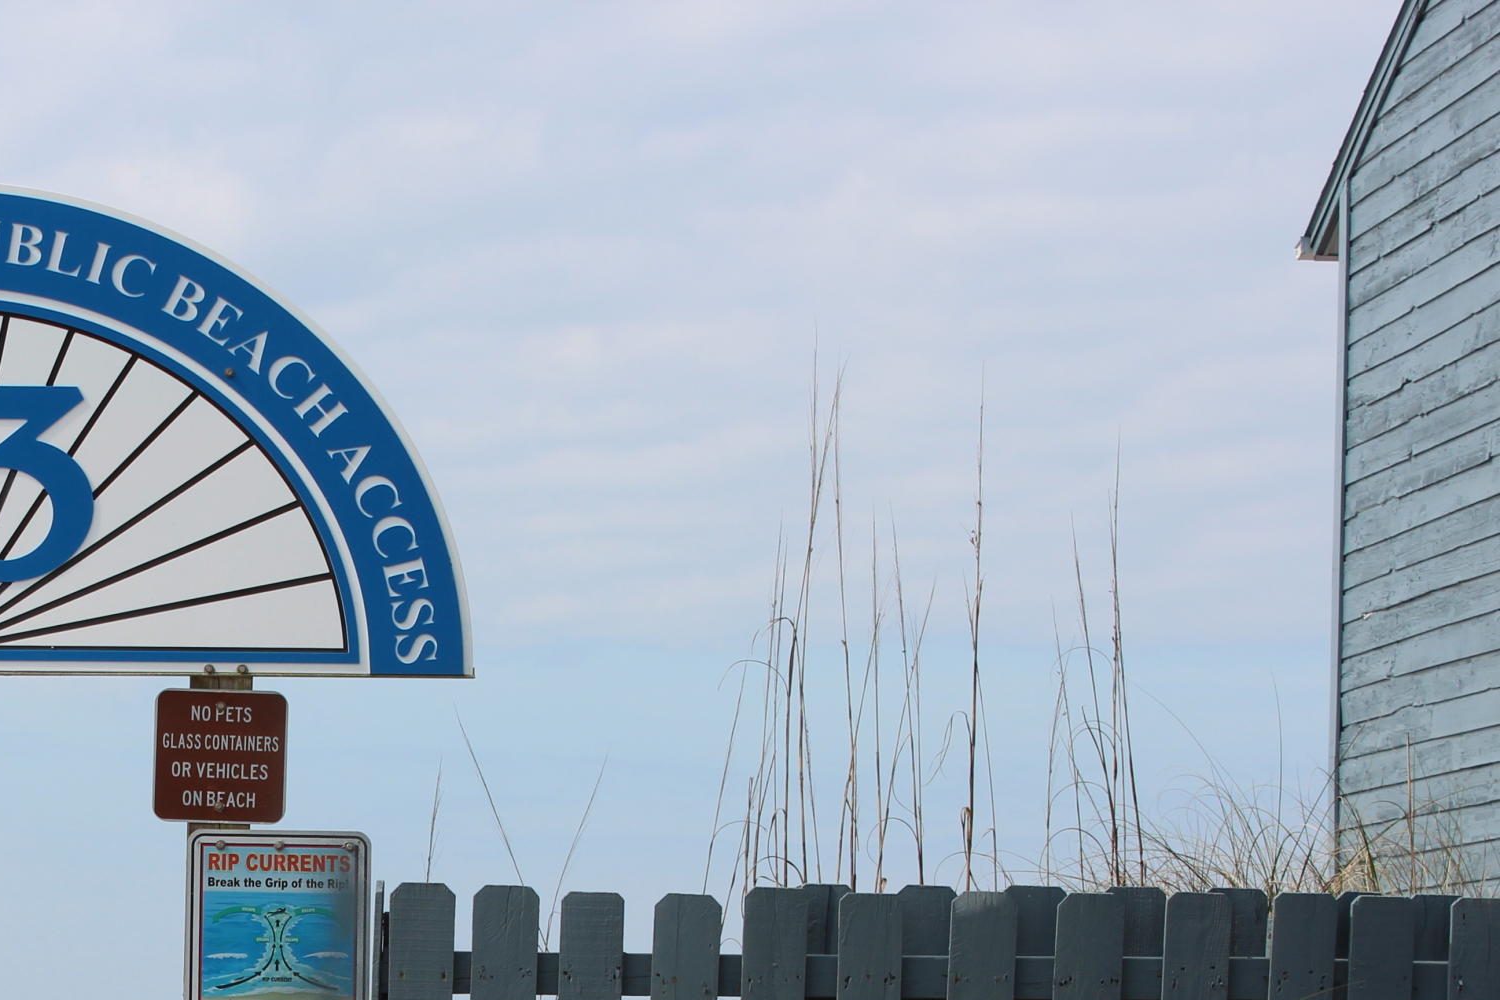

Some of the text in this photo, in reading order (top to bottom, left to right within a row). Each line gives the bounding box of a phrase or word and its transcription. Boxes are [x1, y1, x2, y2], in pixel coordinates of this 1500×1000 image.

[161, 274, 349, 438] BEACH
[327, 443, 438, 665] ACCESS
[191, 705, 252, 723] NO PETS
[162, 733, 279, 752] GLASS CONTAINERS
[172, 762, 268, 780] OR VEHICLES
[182, 790, 256, 808] ON BEACH
[208, 853, 350, 873] RIP CURRENTS
[208, 877, 240, 888] Break
[244, 878, 261, 888] the
[265, 878, 288, 890] Grip
[292, 878, 302, 888] of
[306, 878, 324, 889] the
